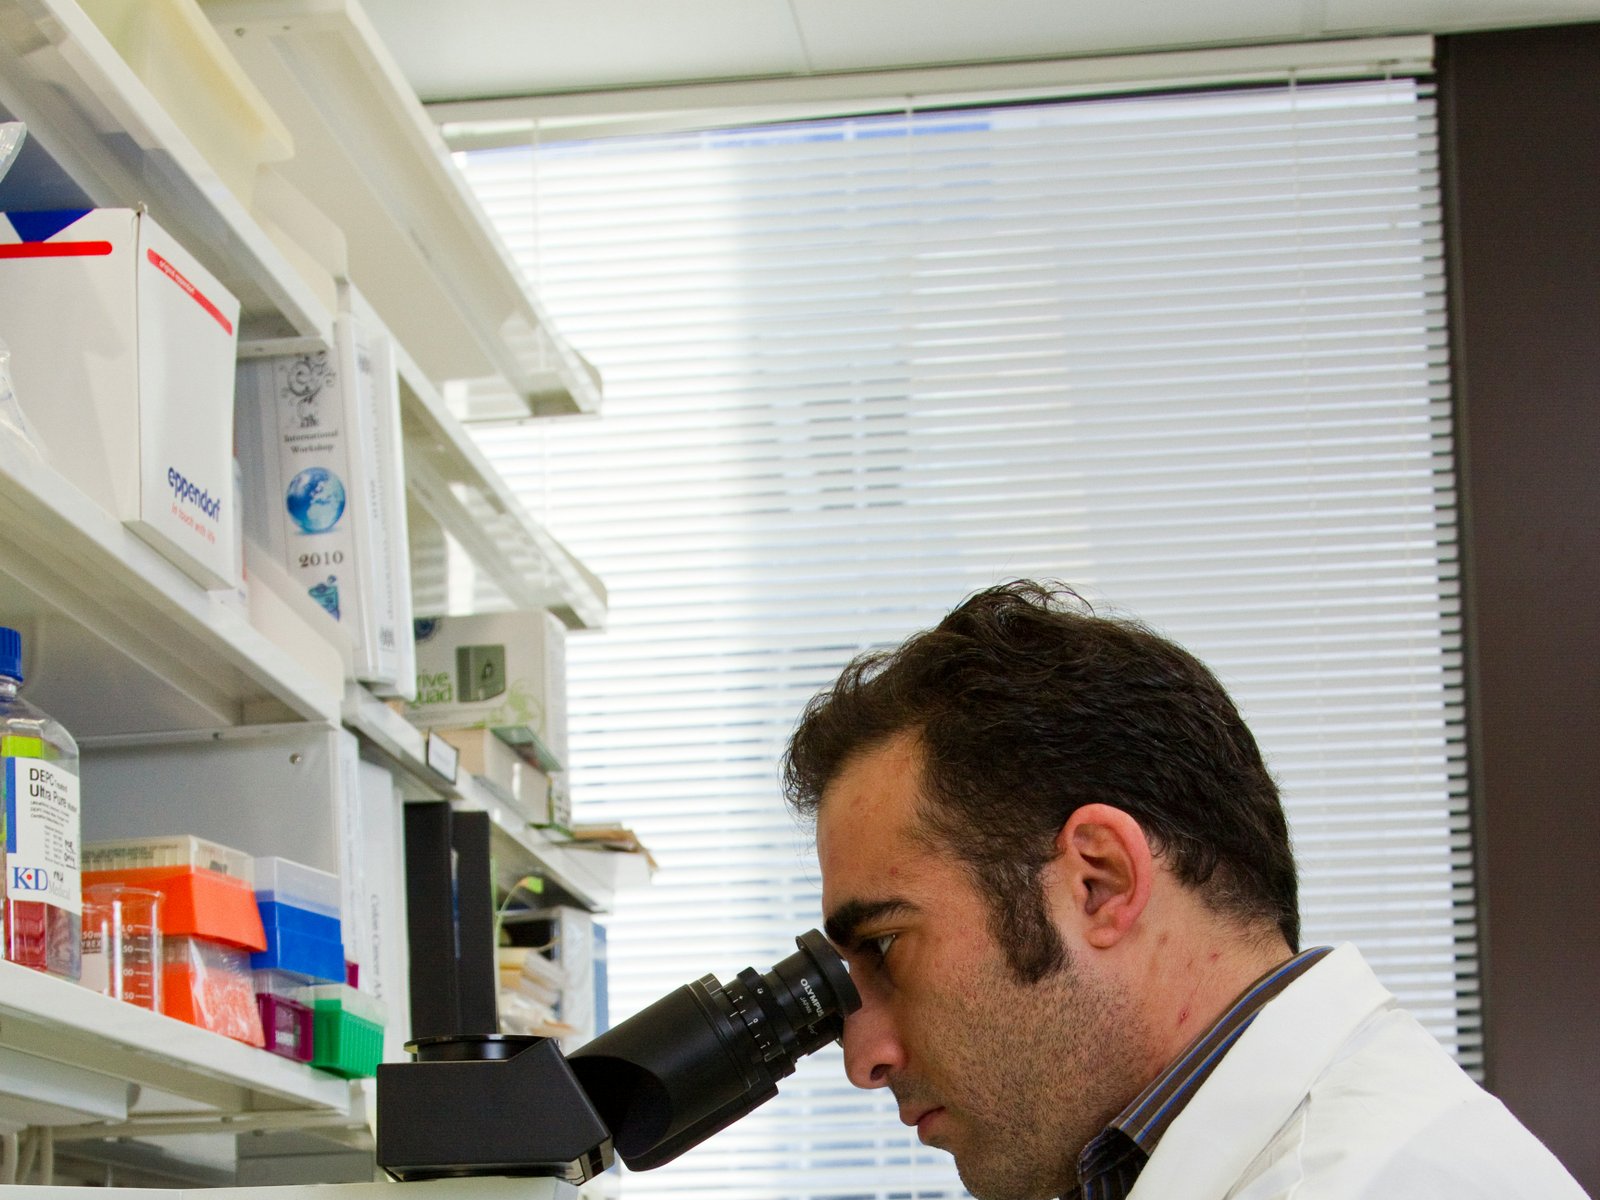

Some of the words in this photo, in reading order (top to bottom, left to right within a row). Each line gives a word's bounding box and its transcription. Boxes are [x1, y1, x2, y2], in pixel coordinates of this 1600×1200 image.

[168, 467, 220, 522] eppendorf
[299, 550, 344, 568] 2010
[29, 768, 55, 786] DEPC
[29, 784, 52, 801] Ultra
[80, 940, 102, 948] YREX
[799, 996, 812, 1014] JAPAN
[800, 978, 824, 1017] OLYMPUS
